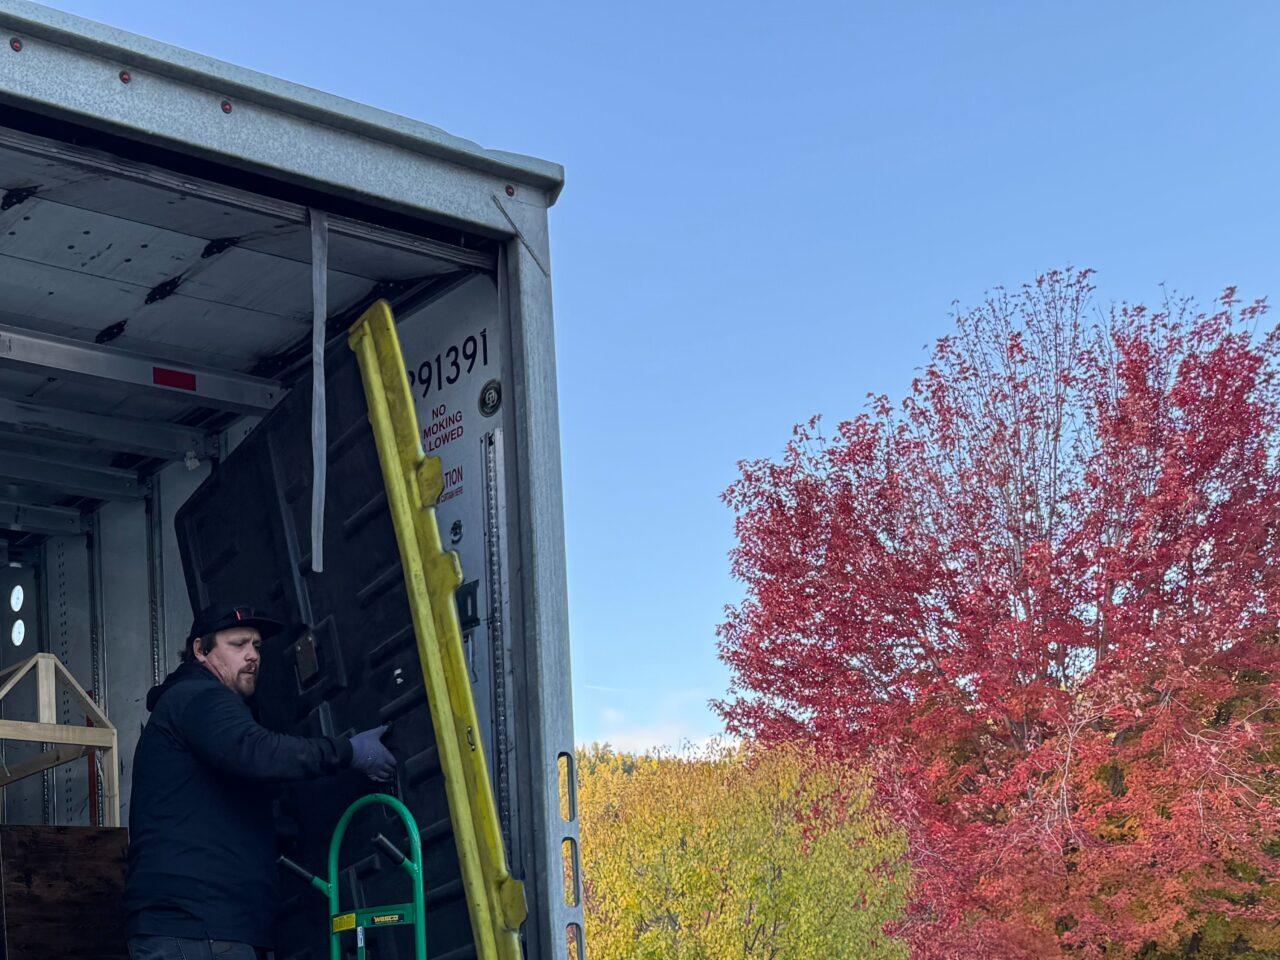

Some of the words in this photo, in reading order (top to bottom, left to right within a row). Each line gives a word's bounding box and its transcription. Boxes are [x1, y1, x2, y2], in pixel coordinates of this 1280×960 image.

[432, 404, 446, 420] NO
[423, 411, 463, 440] MOKING
[444, 465, 463, 489] TION
